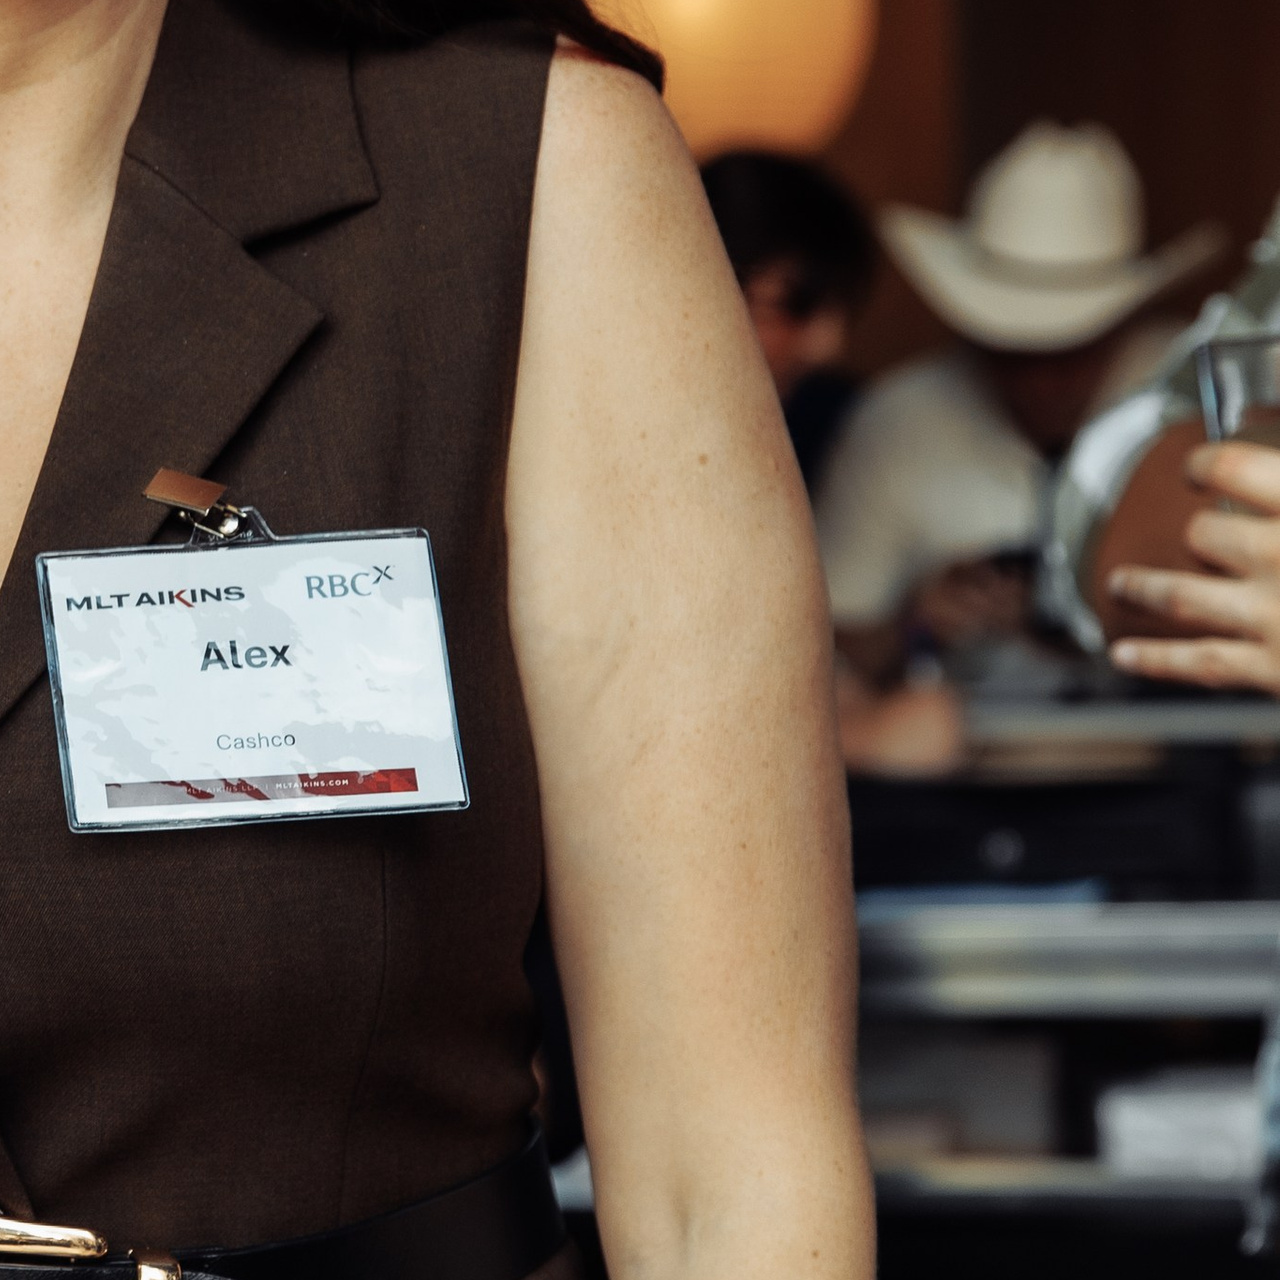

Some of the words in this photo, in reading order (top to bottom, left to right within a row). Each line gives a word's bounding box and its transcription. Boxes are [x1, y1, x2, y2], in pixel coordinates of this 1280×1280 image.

[200, 639, 293, 672] Alex
[216, 732, 296, 751] Cashco
[275, 779, 350, 790] MLTAIKINS.COM
